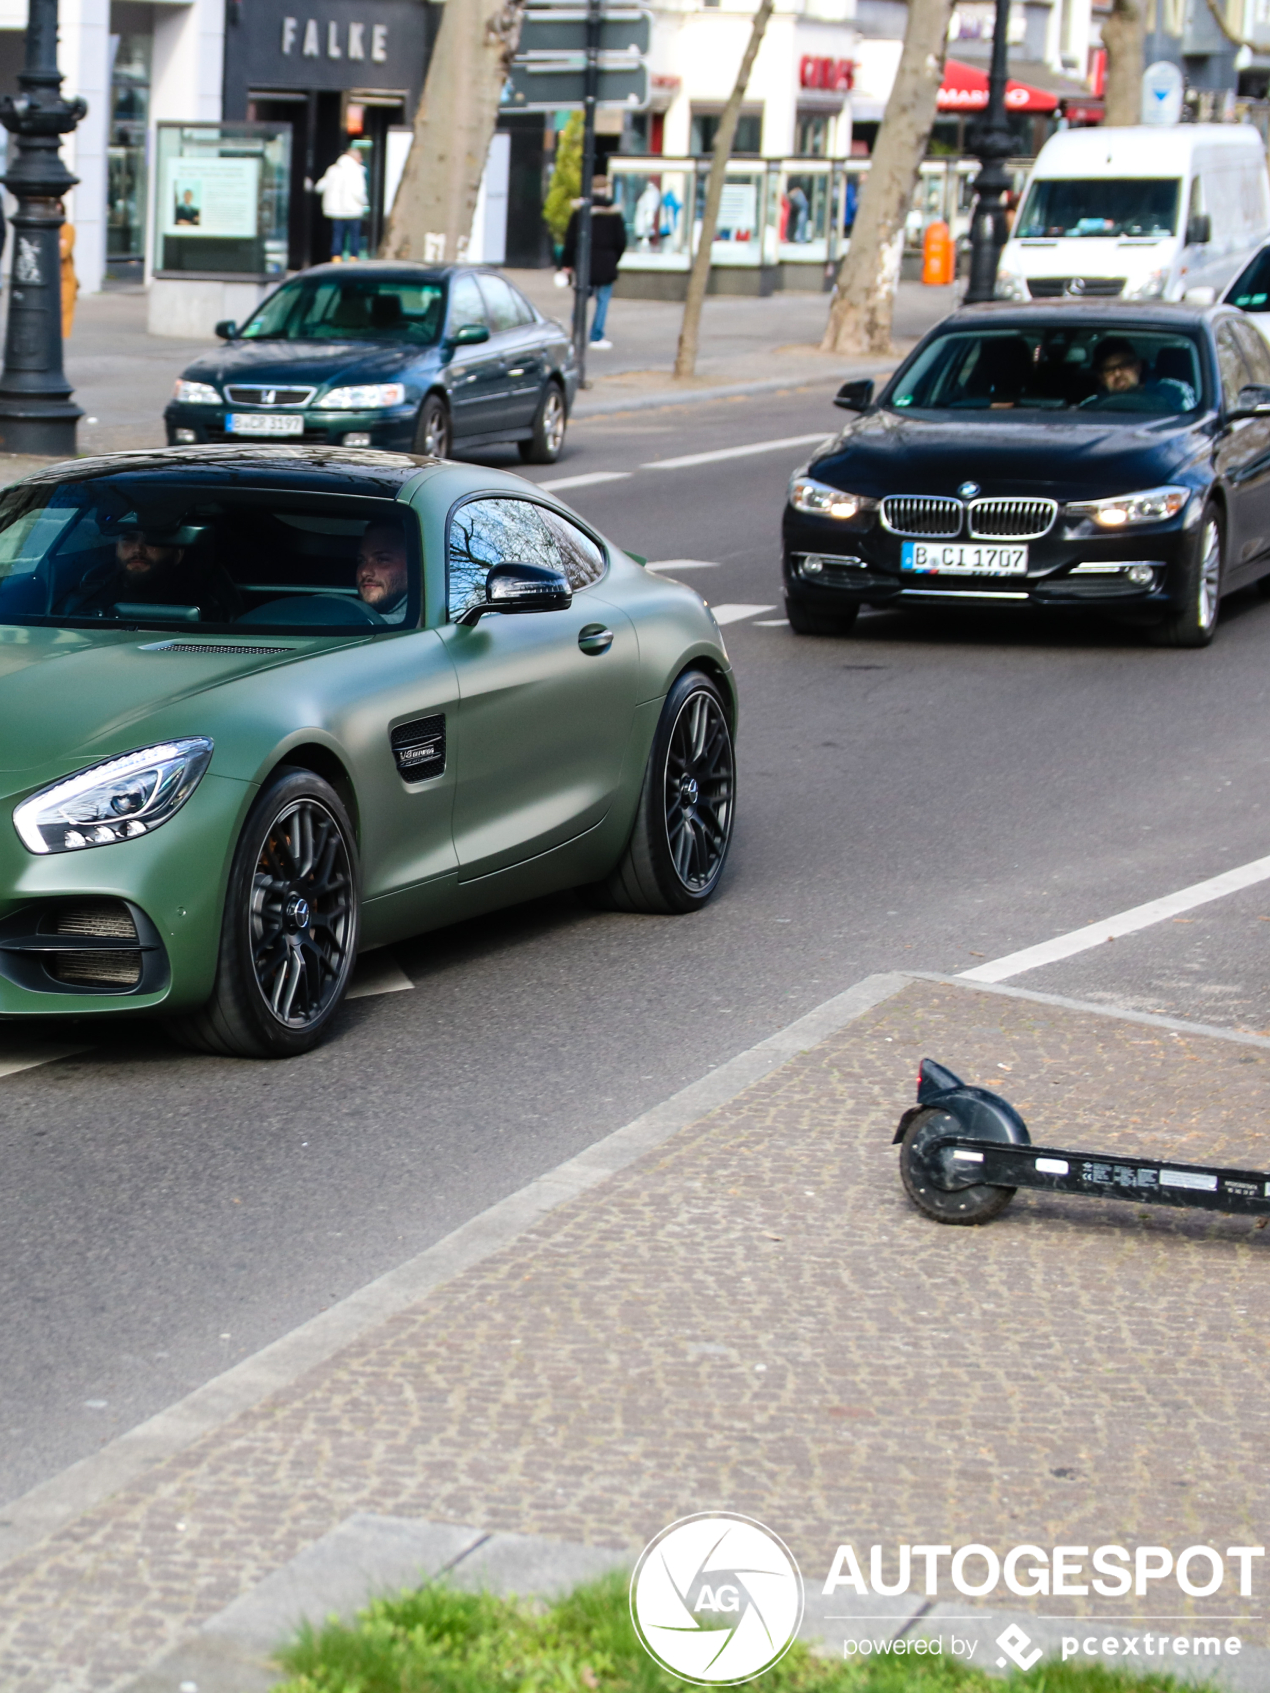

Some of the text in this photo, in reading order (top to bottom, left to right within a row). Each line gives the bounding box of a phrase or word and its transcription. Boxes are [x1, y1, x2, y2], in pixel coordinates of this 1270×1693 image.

[282, 17, 388, 62] FALKE
[270, 416, 301, 430] 3197
[915, 547, 927, 565] B
[942, 548, 966, 567] CI
[972, 549, 1024, 567] 1707
